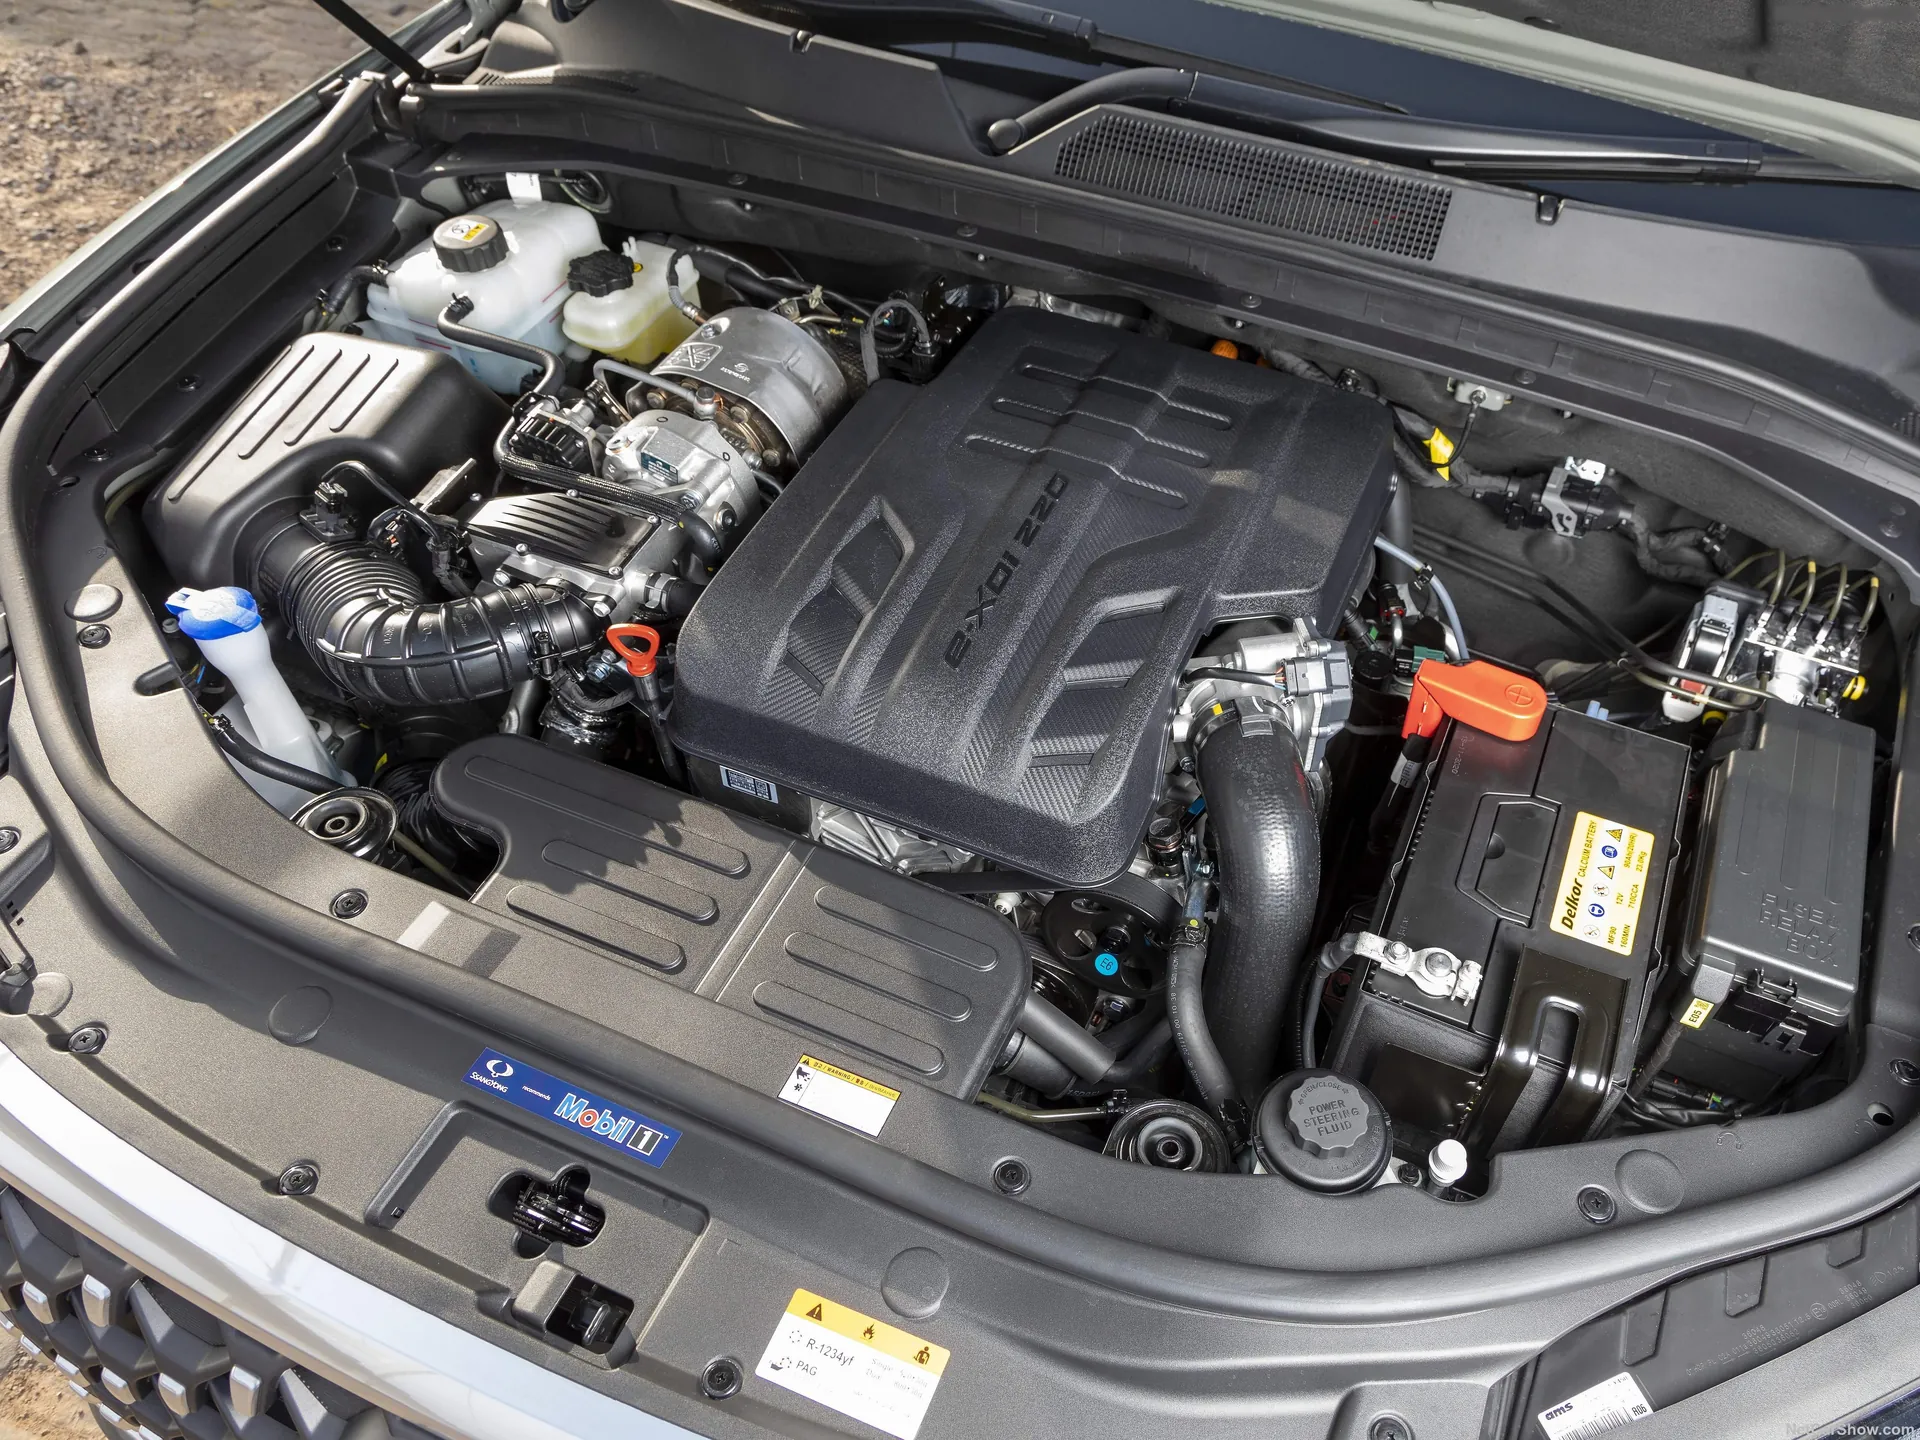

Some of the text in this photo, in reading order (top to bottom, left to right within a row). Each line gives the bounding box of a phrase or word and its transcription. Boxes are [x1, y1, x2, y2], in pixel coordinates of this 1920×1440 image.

[1014, 472, 1069, 547] 220
[1561, 820, 1597, 930] Delkor CALCIUM BATTERY
[1628, 884, 1639, 909] 710CCA
[1607, 926, 1617, 944] MF90
[1616, 892, 1624, 905] 12V
[1762, 892, 1823, 924] FUSE
[1759, 908, 1837, 946] RELAY
[1786, 934, 1839, 968] BOX
[1100, 957, 1114, 971] E6
[1688, 1009, 1703, 1023] E05
[470, 1071, 509, 1093] SSANGYONG
[827, 1067, 851, 1080] WARNING
[521, 1085, 551, 1101] recommends
[554, 1092, 635, 1144] Mobil
[1303, 1107, 1360, 1128] STEERING
[1308, 1099, 1346, 1116] POWER
[1317, 1120, 1352, 1137] FLUID
[805, 1338, 855, 1367] R-1234yf
[795, 1360, 818, 1376] PAG
[1545, 1402, 1574, 1421] ams
